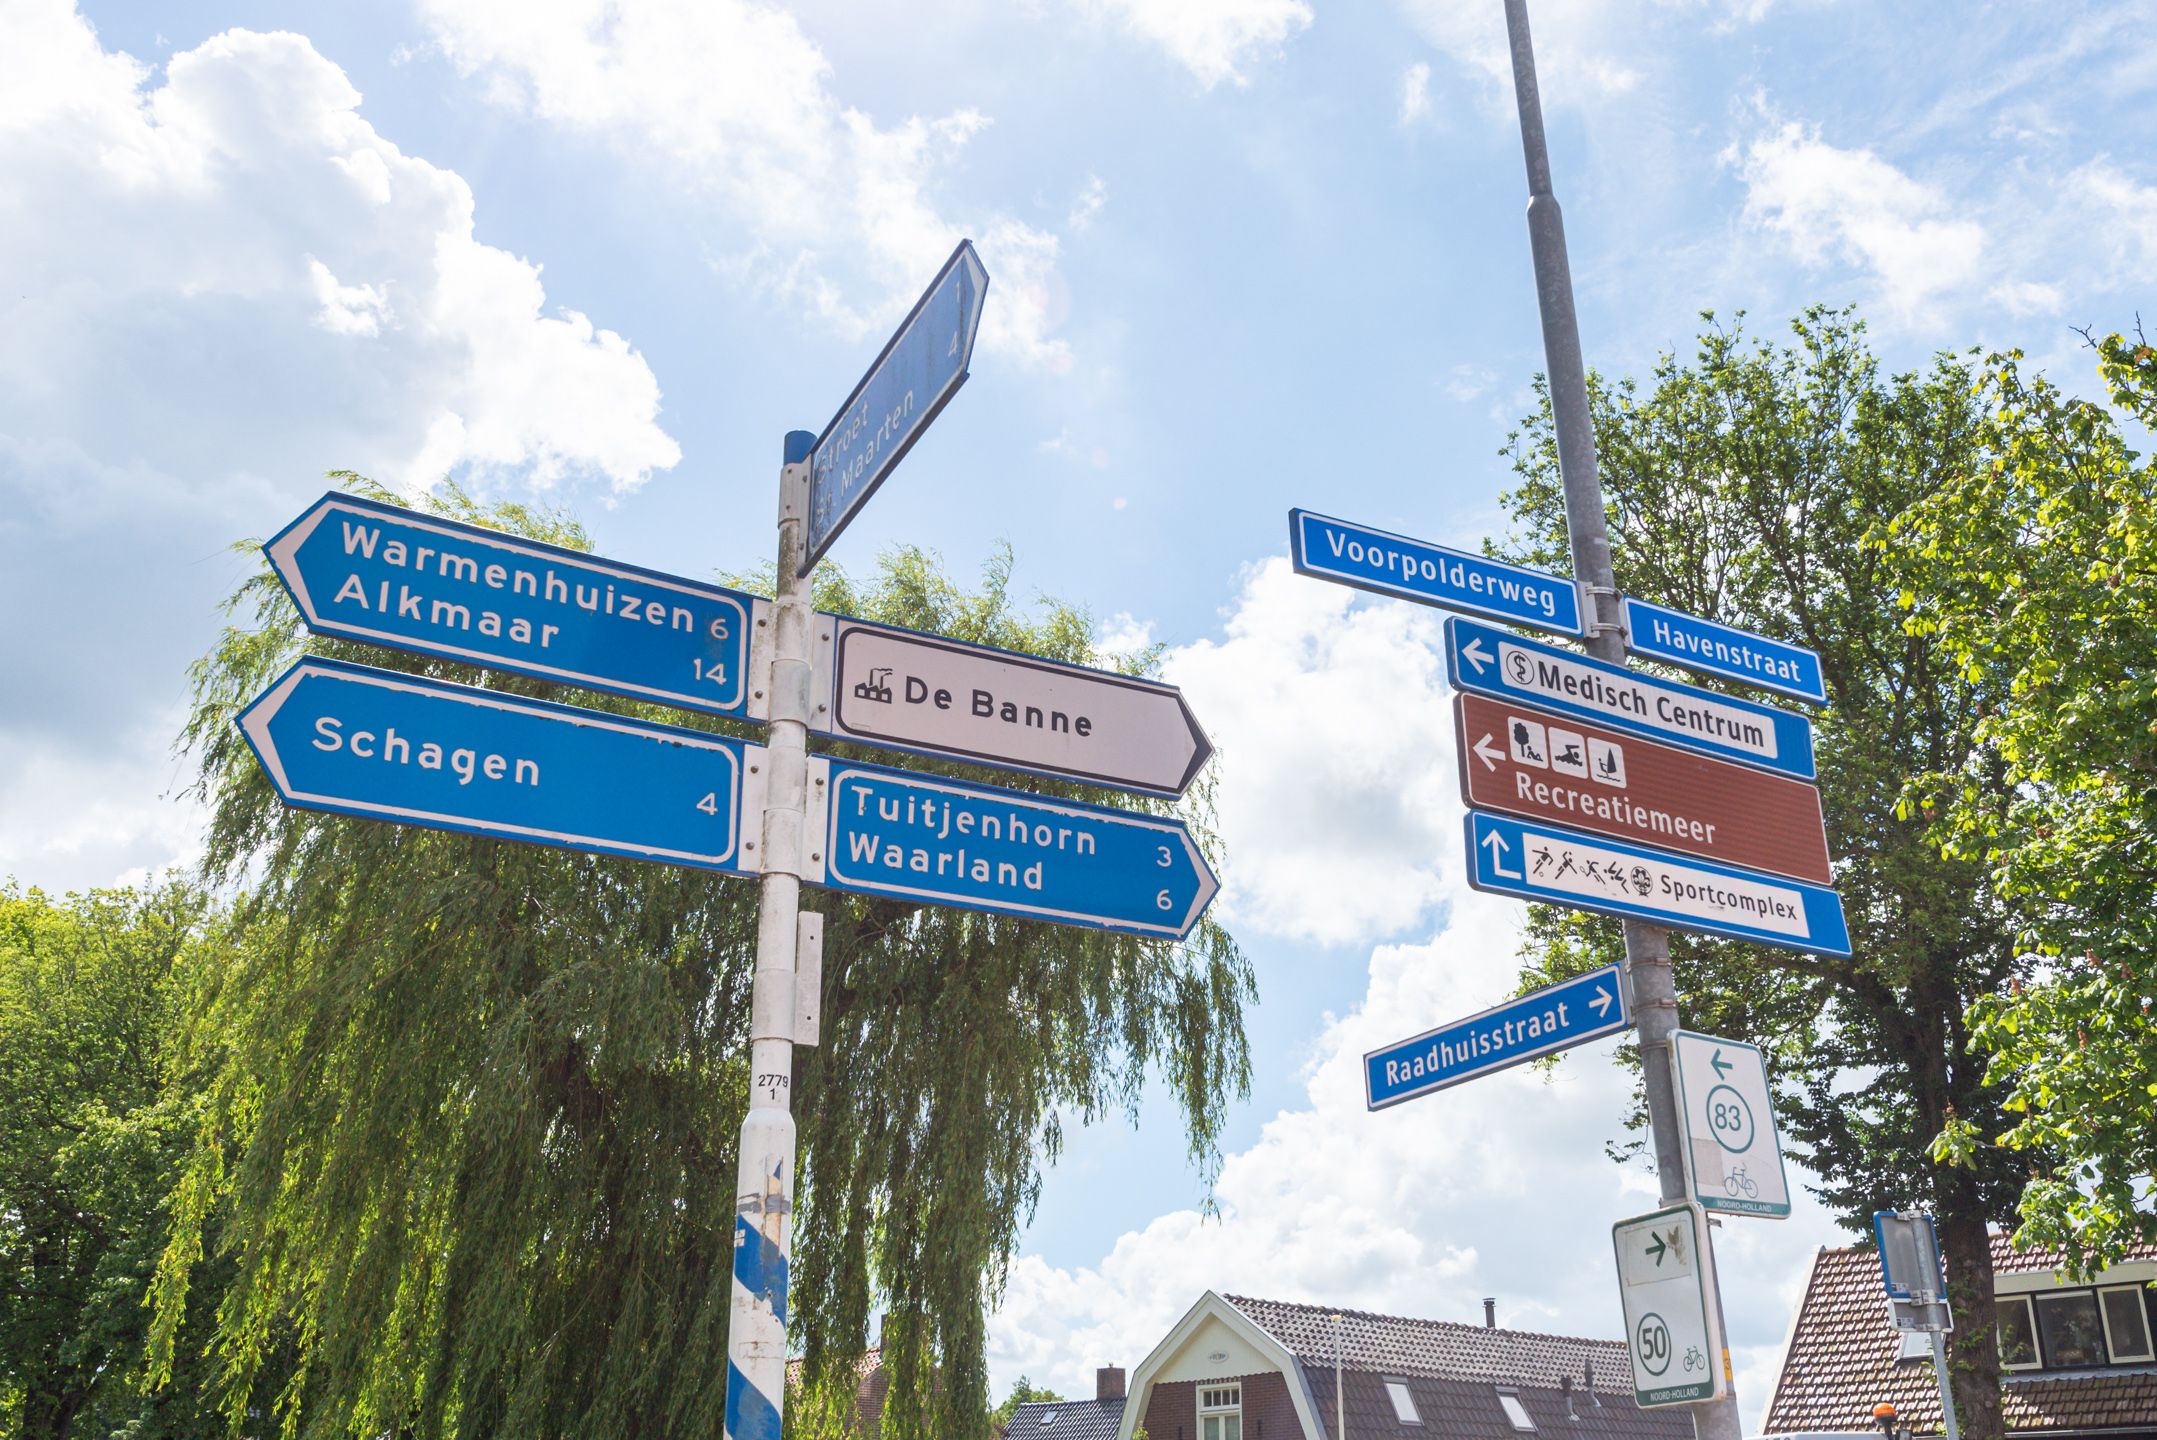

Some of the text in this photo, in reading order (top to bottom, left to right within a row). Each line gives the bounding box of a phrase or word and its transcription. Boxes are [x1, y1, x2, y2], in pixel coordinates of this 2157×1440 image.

[955, 280, 960, 303] 1
[841, 389, 913, 496] Maarten
[947, 330, 958, 357] 4
[342, 521, 730, 640] Warmenhuizen 6
[1325, 529, 1555, 617] Voorpolderweg
[333, 573, 728, 685] Alkmaar 14
[1653, 619, 1802, 683] Havenstraat
[905, 675, 1093, 737] De Banne
[1538, 661, 1765, 748] Medisch Centrum
[311, 716, 719, 816] Schagen 4
[850, 785, 1172, 868] Tuitjenhorn 3
[1516, 771, 1716, 845] Recreatiemeer
[848, 832, 1173, 911] Waarland 6
[1660, 874, 1797, 922] Sportcomplex
[1386, 1003, 1570, 1087] Raadhuisstraat
[758, 1074, 789, 1088] 2779
[769, 1088, 775, 1100] 1
[1714, 1103, 1741, 1132] 83
[1716, 1200, 1773, 1213] NOORD-HOLLAND
[1642, 1325, 1667, 1360] 50
[1649, 1386, 1700, 1401] NOORD-HOLLAND
